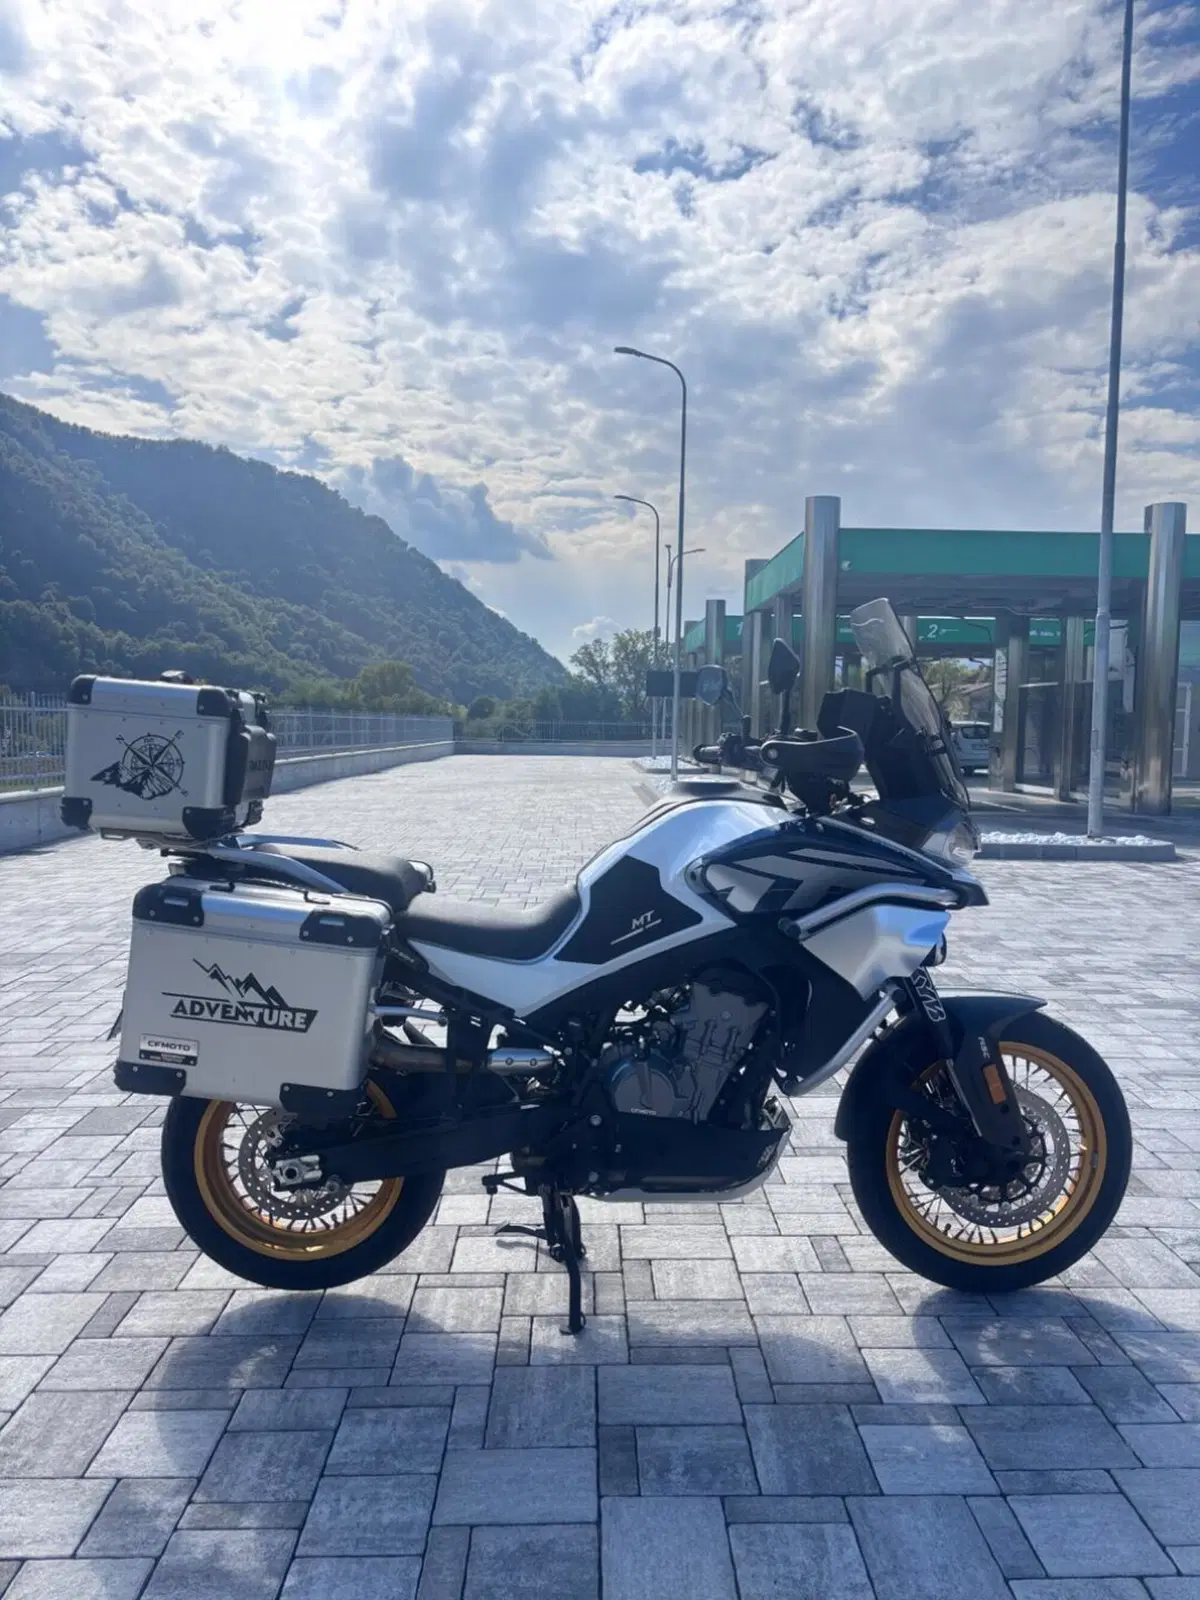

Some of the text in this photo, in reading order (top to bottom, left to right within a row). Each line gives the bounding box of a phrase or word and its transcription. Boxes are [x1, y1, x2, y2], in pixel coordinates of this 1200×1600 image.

[927, 624, 938, 638] 2
[631, 910, 656, 930] MT
[173, 1000, 308, 1029] ADVENTURE
[147, 1040, 191, 1051] CFMOTO
